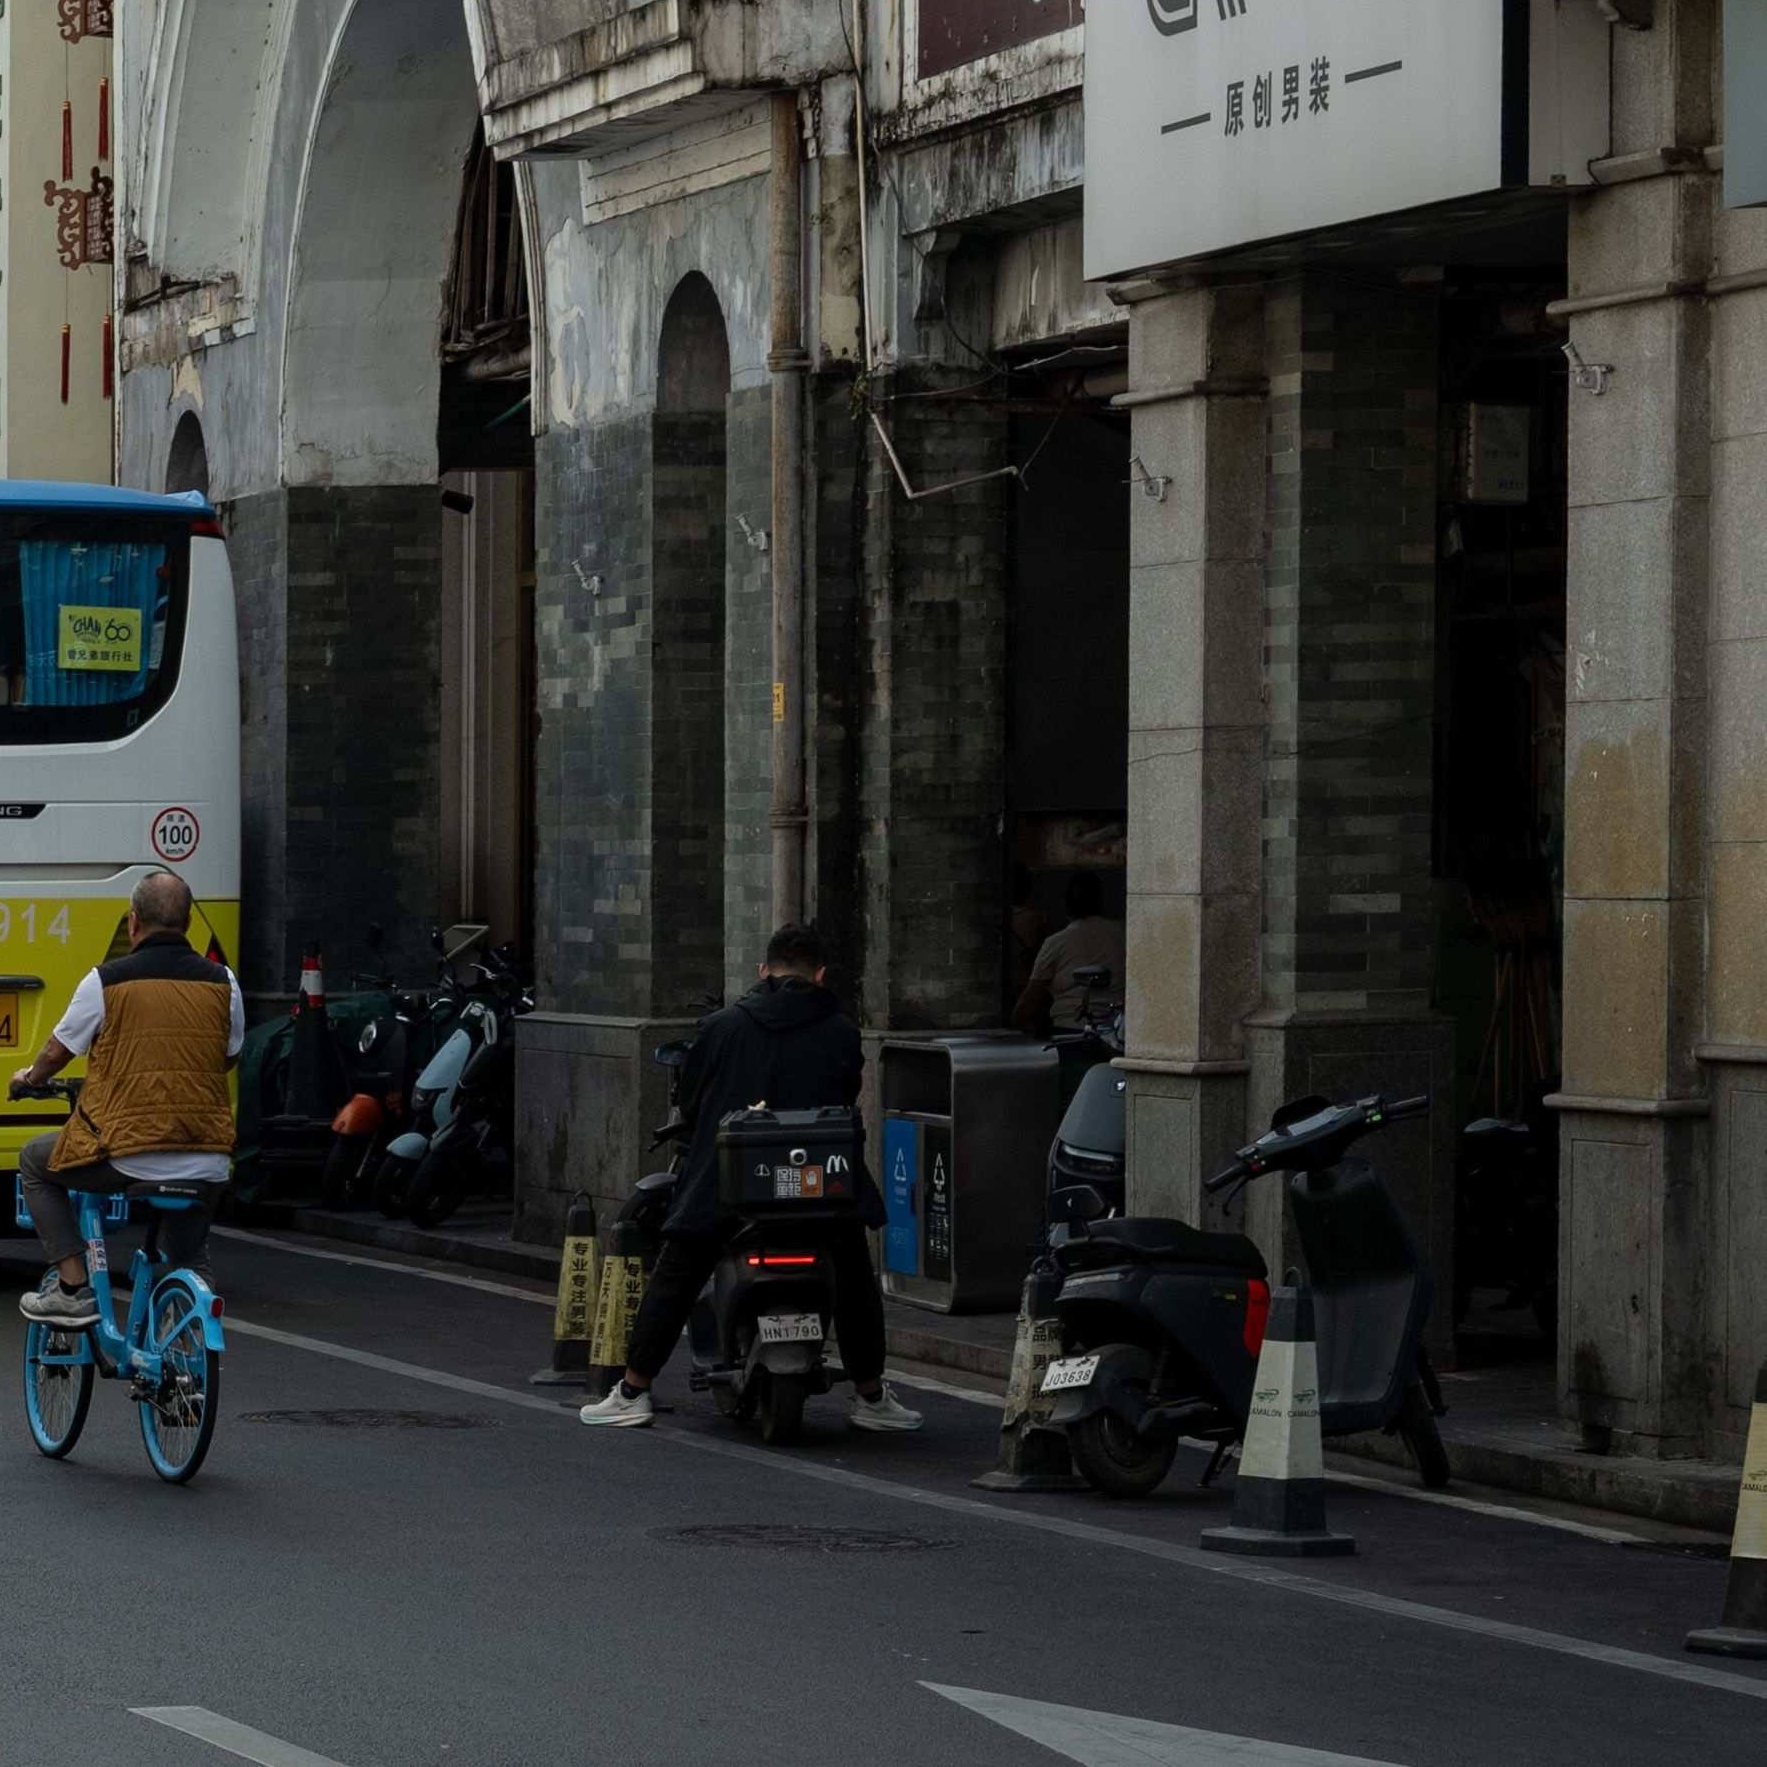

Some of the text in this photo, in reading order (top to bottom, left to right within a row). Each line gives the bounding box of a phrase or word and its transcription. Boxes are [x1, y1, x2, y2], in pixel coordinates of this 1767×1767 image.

[1224, 55, 1331, 138] 原创男装
[159, 825, 192, 844] 100
[764, 1325, 820, 1340] HN1790
[1046, 1369, 1092, 1387] J03638
